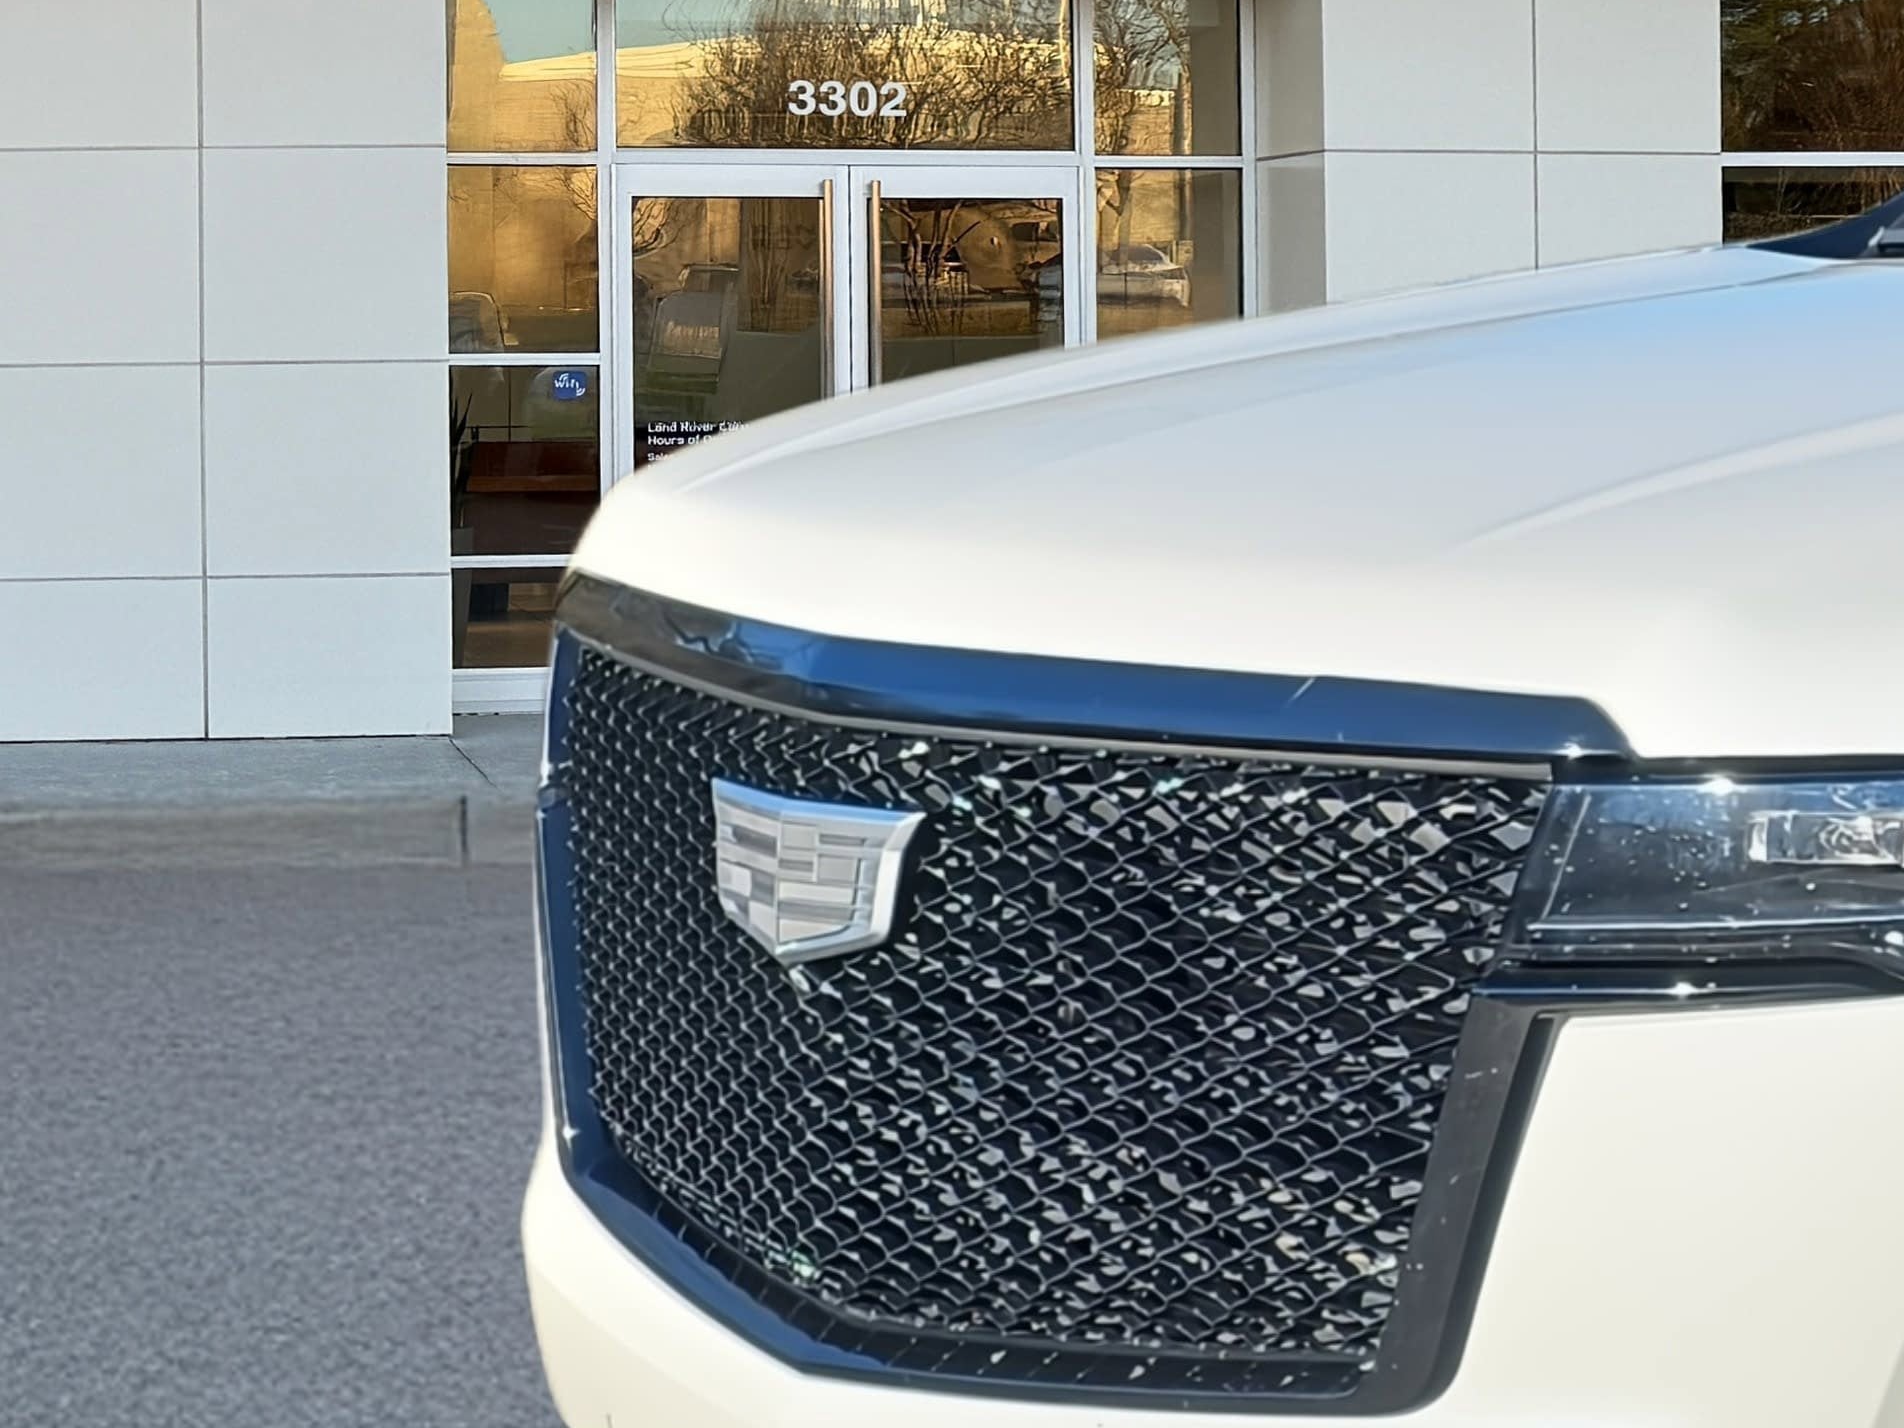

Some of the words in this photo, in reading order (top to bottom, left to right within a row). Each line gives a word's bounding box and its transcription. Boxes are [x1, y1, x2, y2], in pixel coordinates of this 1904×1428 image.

[787, 79, 908, 119] 3302
[648, 421, 677, 433] Land
[680, 421, 717, 433] Rover
[648, 435, 685, 446] Hours
